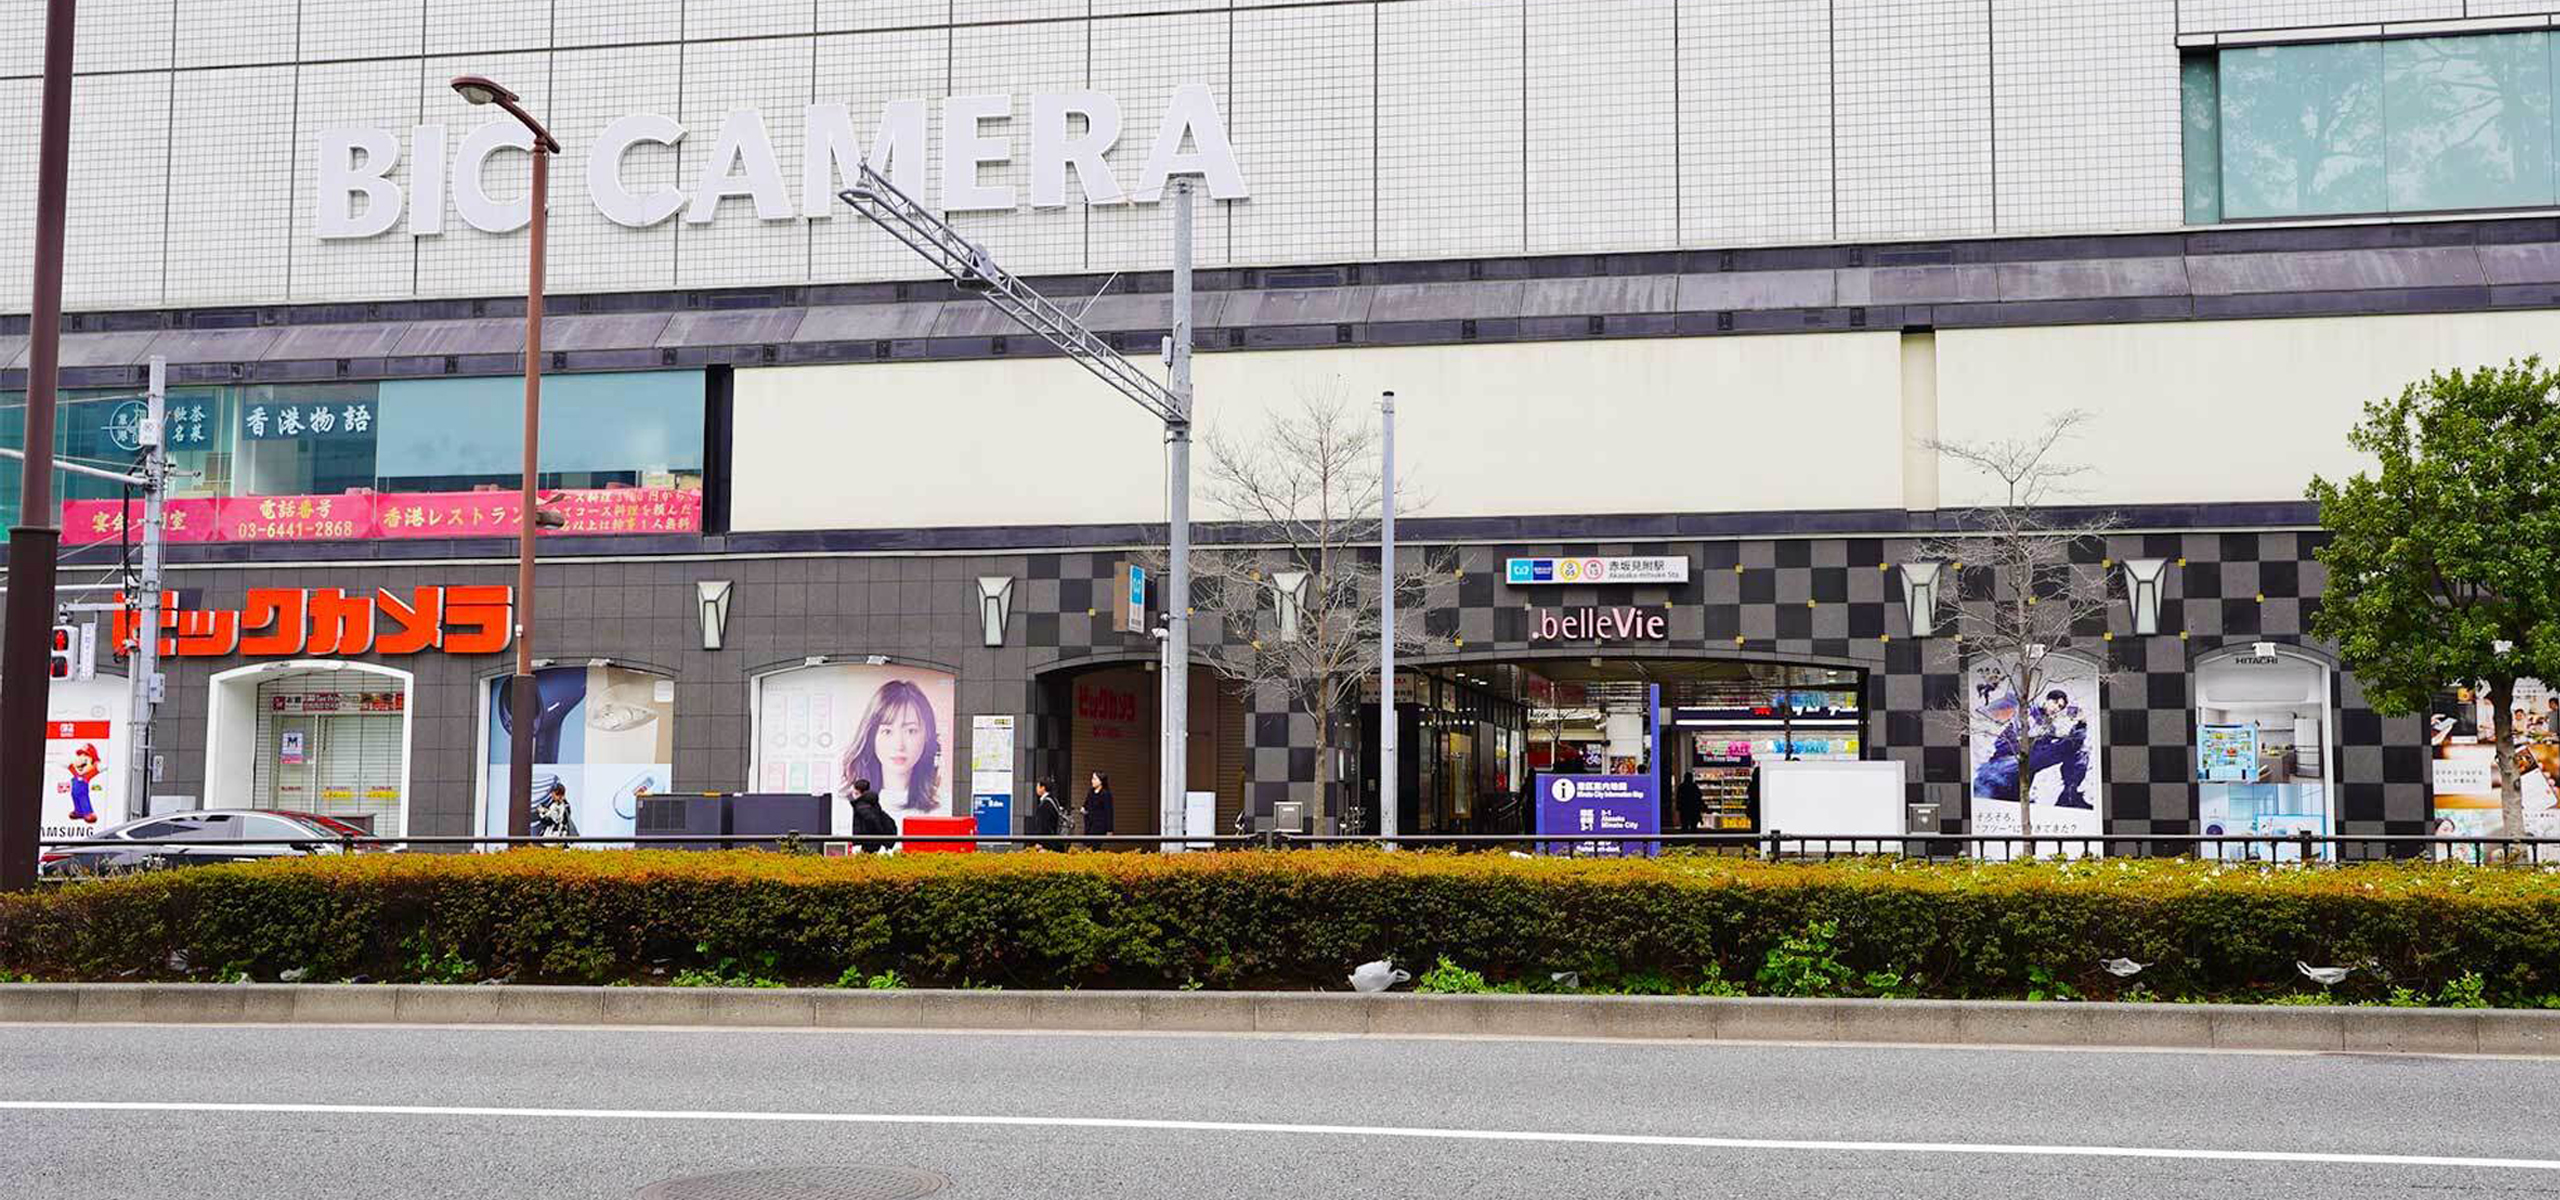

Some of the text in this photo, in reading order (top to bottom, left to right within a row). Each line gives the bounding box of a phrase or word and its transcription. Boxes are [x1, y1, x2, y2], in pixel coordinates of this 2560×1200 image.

[315, 82, 1251, 240] BIC CAMERA
[247, 404, 372, 438] 香港物語
[259, 498, 332, 519] 電話番号
[383, 505, 525, 528] 香港レストラン
[238, 520, 353, 538] 03-6441-2868
[112, 584, 515, 657] ビックカメラ
